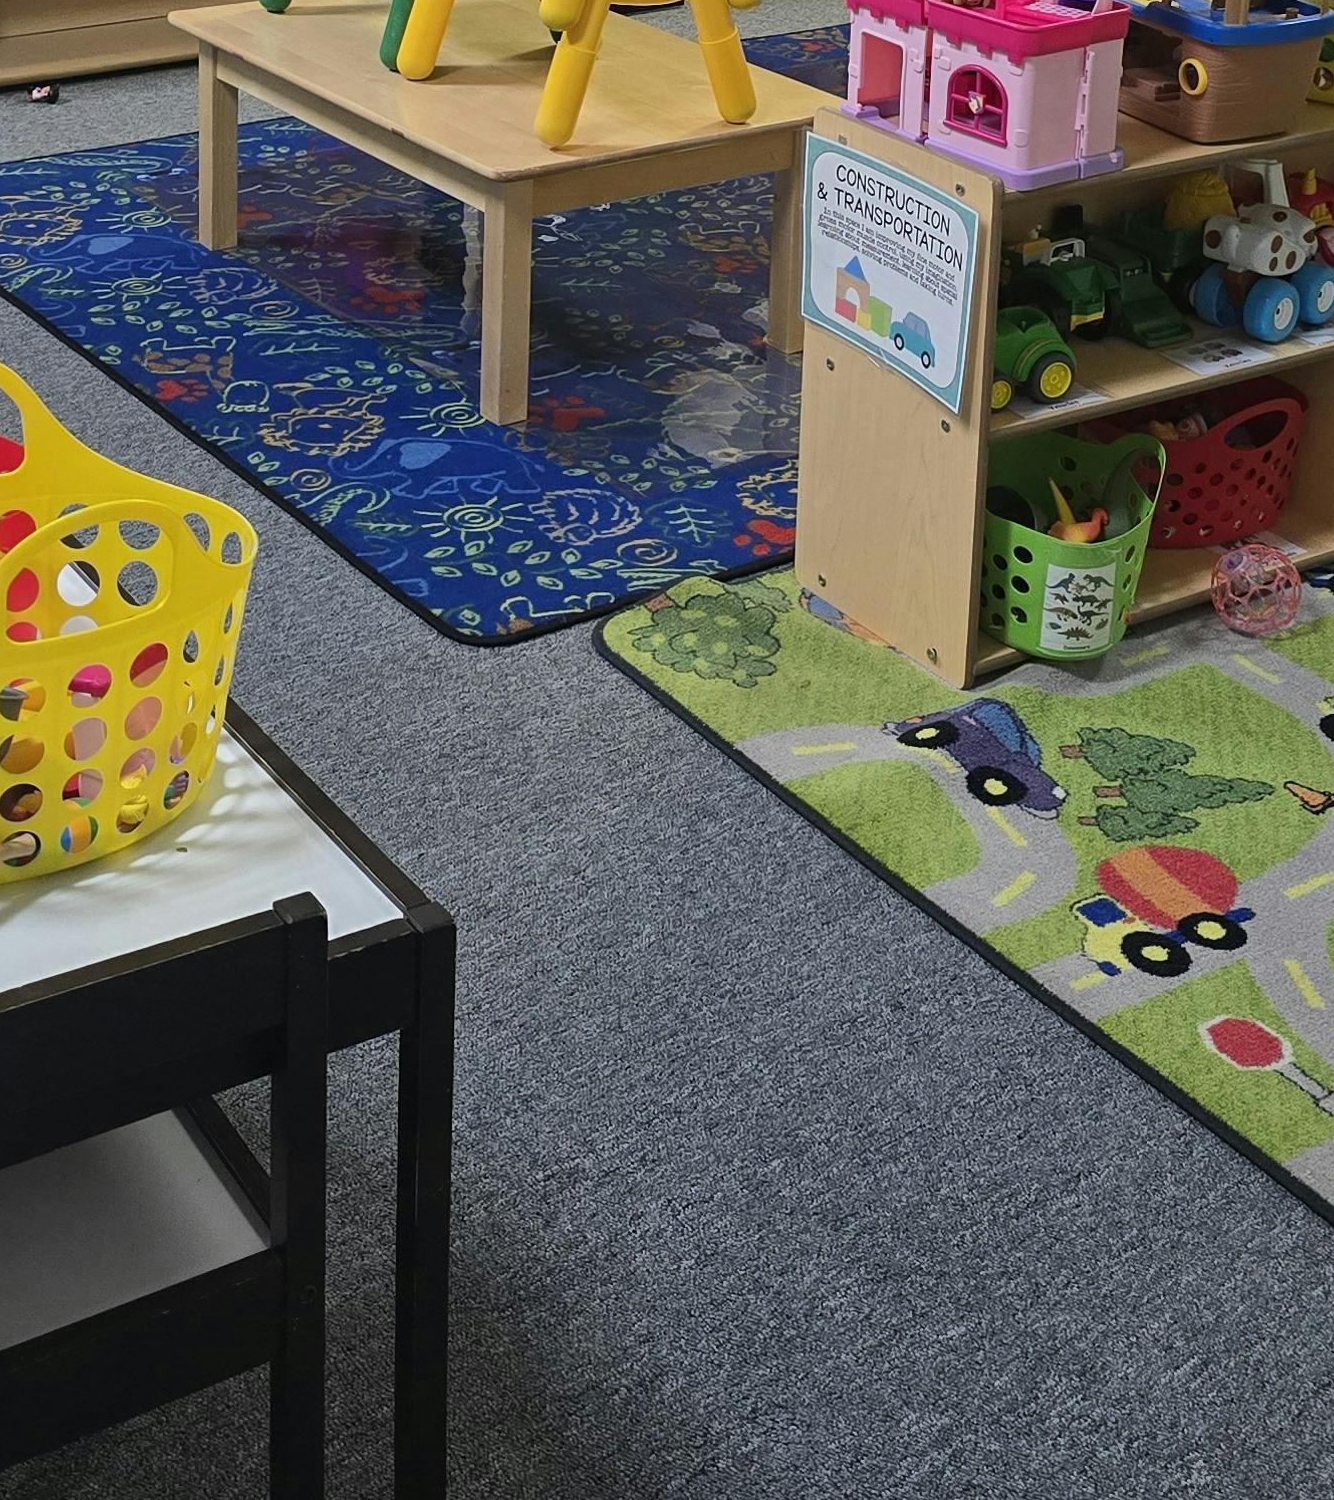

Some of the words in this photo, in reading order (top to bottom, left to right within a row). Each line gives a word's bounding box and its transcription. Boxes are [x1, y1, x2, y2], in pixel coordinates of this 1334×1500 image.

[816, 181, 828, 201] &
[834, 187, 963, 271] TRANSPORTATION
[835, 164, 950, 237] CONSTRUCTION
